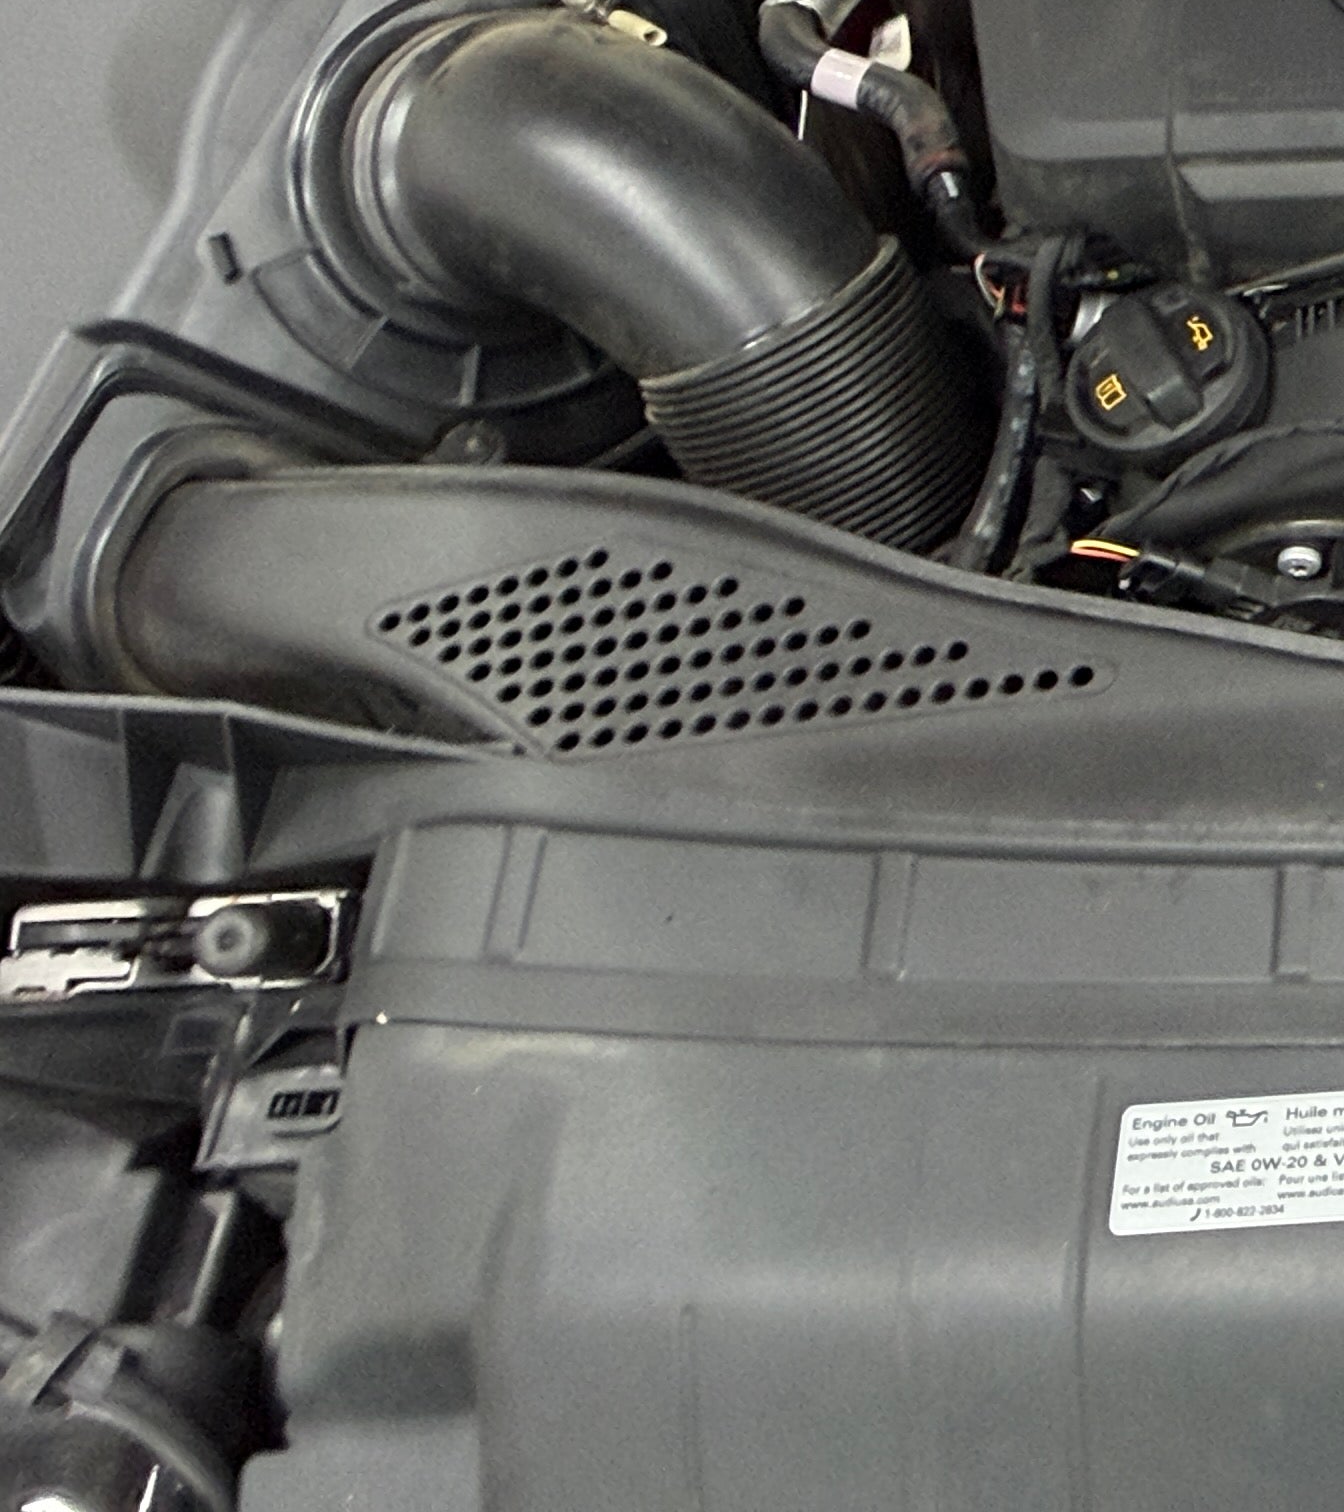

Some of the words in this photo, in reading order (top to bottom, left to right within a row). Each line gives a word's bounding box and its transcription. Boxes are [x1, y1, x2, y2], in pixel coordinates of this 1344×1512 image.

[1286, 1105, 1328, 1120] Huile
[1132, 1115, 1188, 1131] Engine
[1193, 1113, 1216, 1126] Oil
[1128, 1137, 1150, 1147] Use
[1153, 1134, 1177, 1145] only
[1180, 1133, 1194, 1143] oil
[1197, 1132, 1220, 1142] that
[1282, 1140, 1300, 1152] qui
[1127, 1150, 1178, 1162] expressly
[1180, 1147, 1229, 1158] complies
[1232, 1143, 1256, 1153] with
[1210, 1159, 1246, 1174] SAE
[1251, 1155, 1308, 1171] 0W-20
[1313, 1154, 1327, 1167] &
[1122, 1184, 1140, 1195] For
[1144, 1186, 1150, 1194] a
[1153, 1183, 1169, 1192] list
[1172, 1181, 1185, 1192] of
[1187, 1178, 1239, 1191] approved
[1279, 1174, 1305, 1185] Pour
[1308, 1174, 1328, 1183] une
